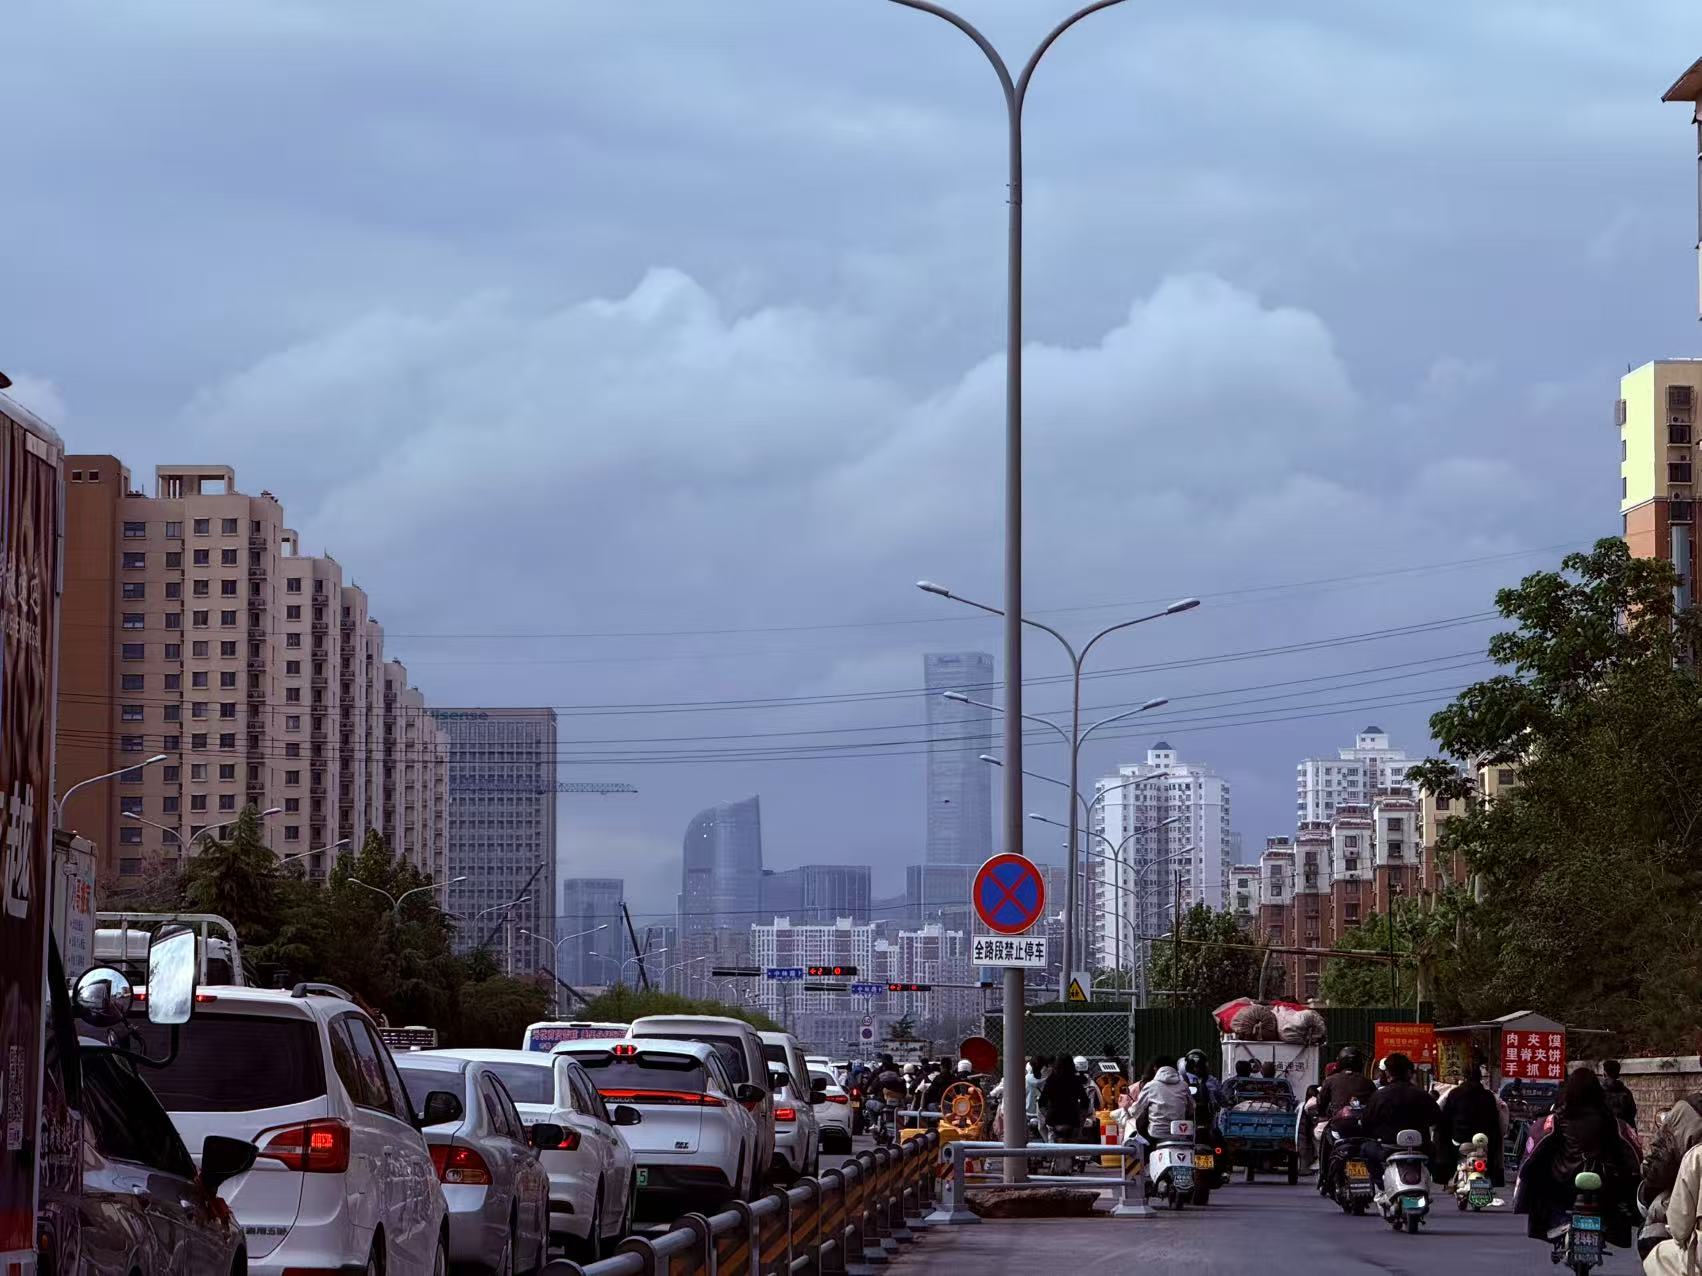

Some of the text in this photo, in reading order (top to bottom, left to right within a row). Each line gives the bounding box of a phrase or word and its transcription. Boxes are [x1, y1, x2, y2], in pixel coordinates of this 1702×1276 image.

[974, 939, 1044, 961] 全路段禁止停车
[1506, 1033, 1562, 1047] 肉夹馍
[1505, 1048, 1561, 1062] 里脊夹饼
[1505, 1063, 1561, 1077] 手抓饼
